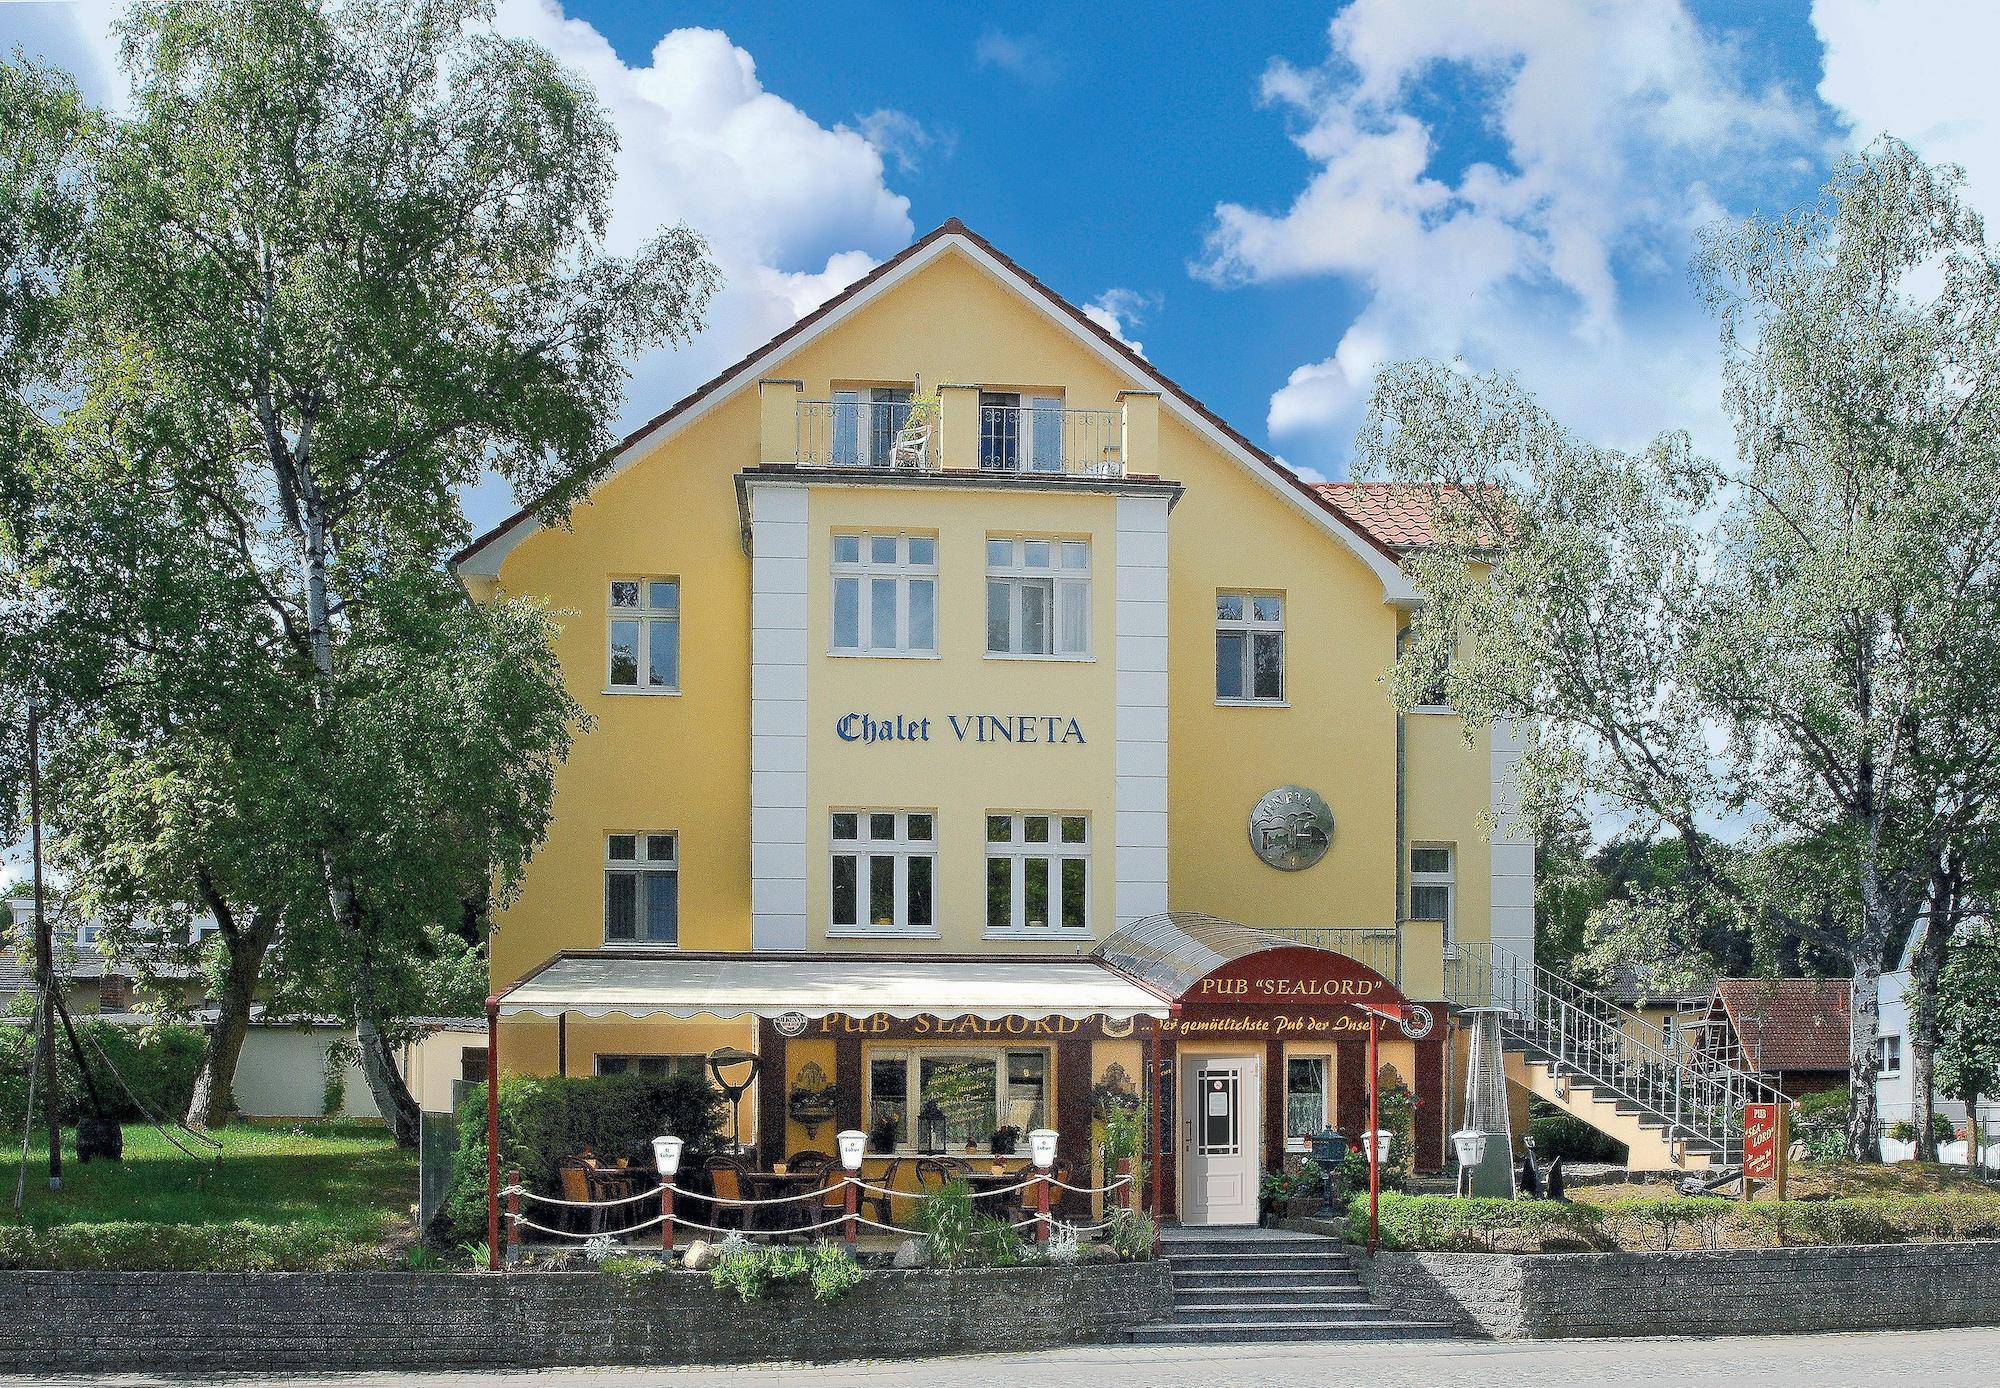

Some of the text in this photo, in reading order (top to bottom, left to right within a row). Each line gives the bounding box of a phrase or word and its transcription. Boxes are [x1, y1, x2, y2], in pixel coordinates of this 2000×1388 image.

[836, 712, 1086, 745] Chalet VINETA
[1201, 978, 1248, 994] PUB
[820, 1012, 890, 1033] PUB
[1181, 1015, 1269, 1035] gemütlichste
[1273, 1015, 1304, 1034] Pub
[1307, 1017, 1329, 1031] der
[1753, 1109, 1766, 1119] PUB
